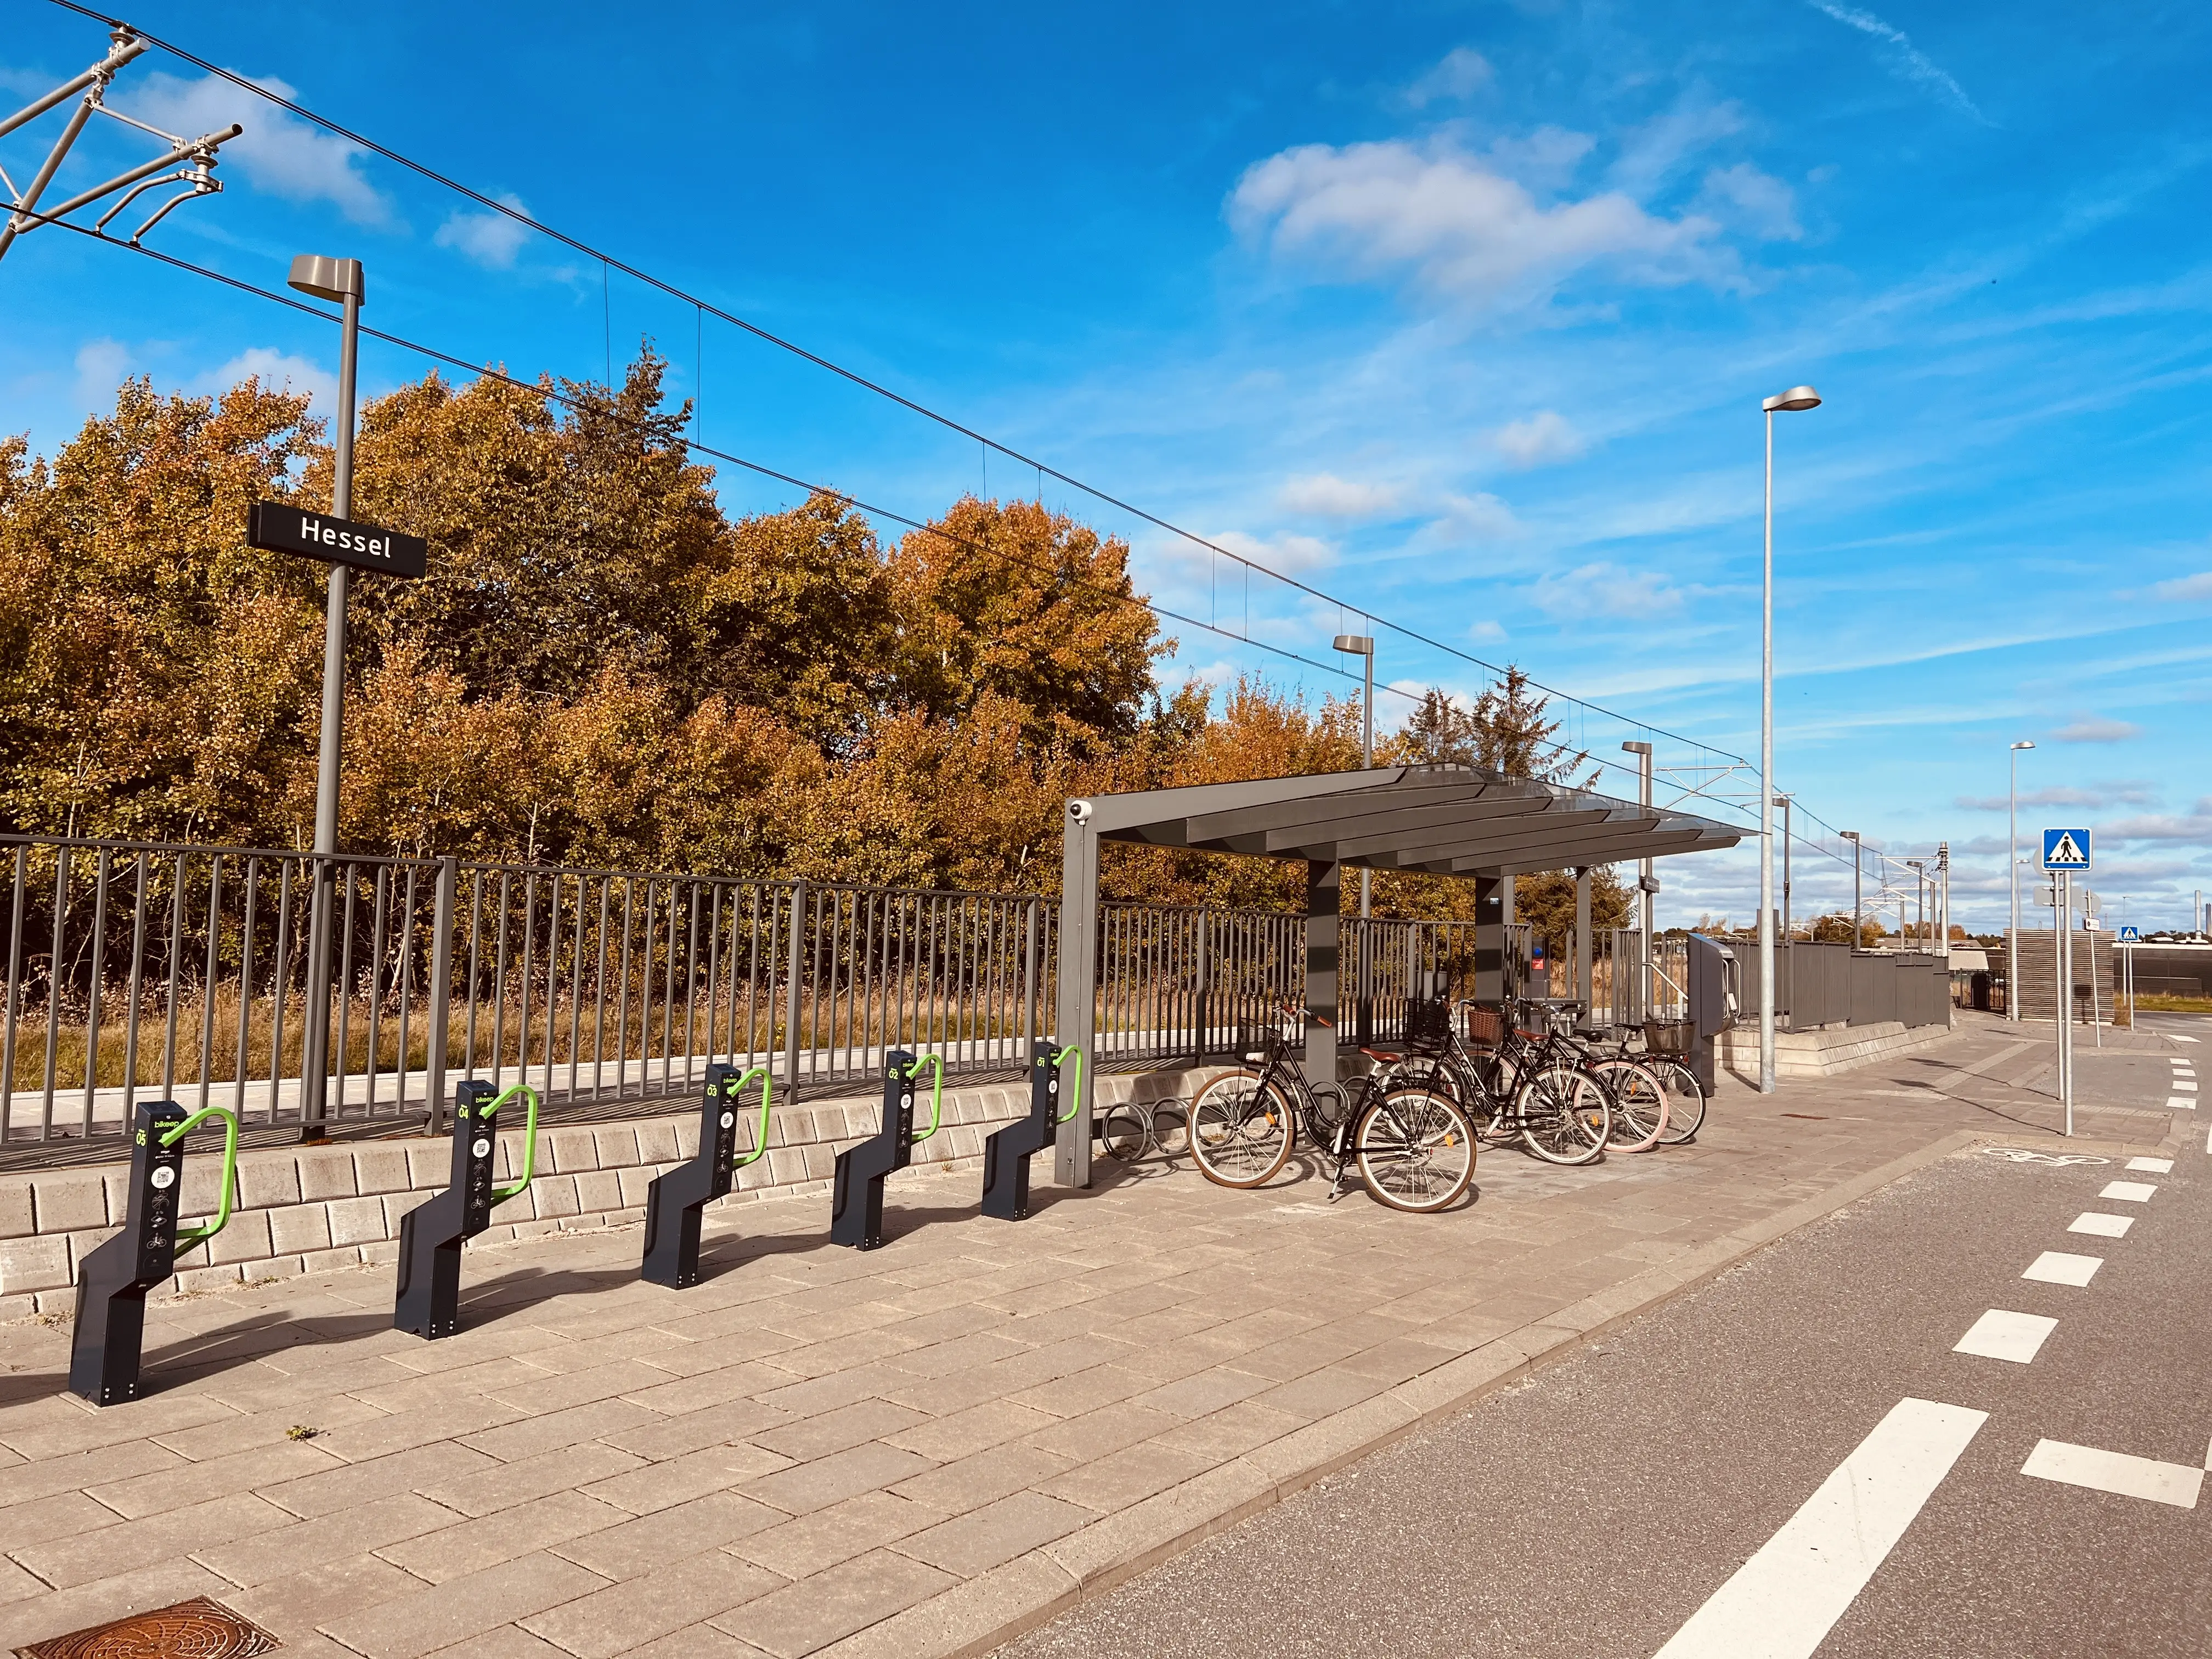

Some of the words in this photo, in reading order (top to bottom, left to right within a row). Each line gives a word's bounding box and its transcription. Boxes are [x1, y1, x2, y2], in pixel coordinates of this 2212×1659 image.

[301, 517, 391, 558] Hessel
[1037, 1059, 1045, 1068] 01
[889, 1070, 899, 1080] 02
[707, 1086, 717, 1097] 03
[459, 1107, 469, 1120] 04
[136, 1132, 146, 1147] 05
